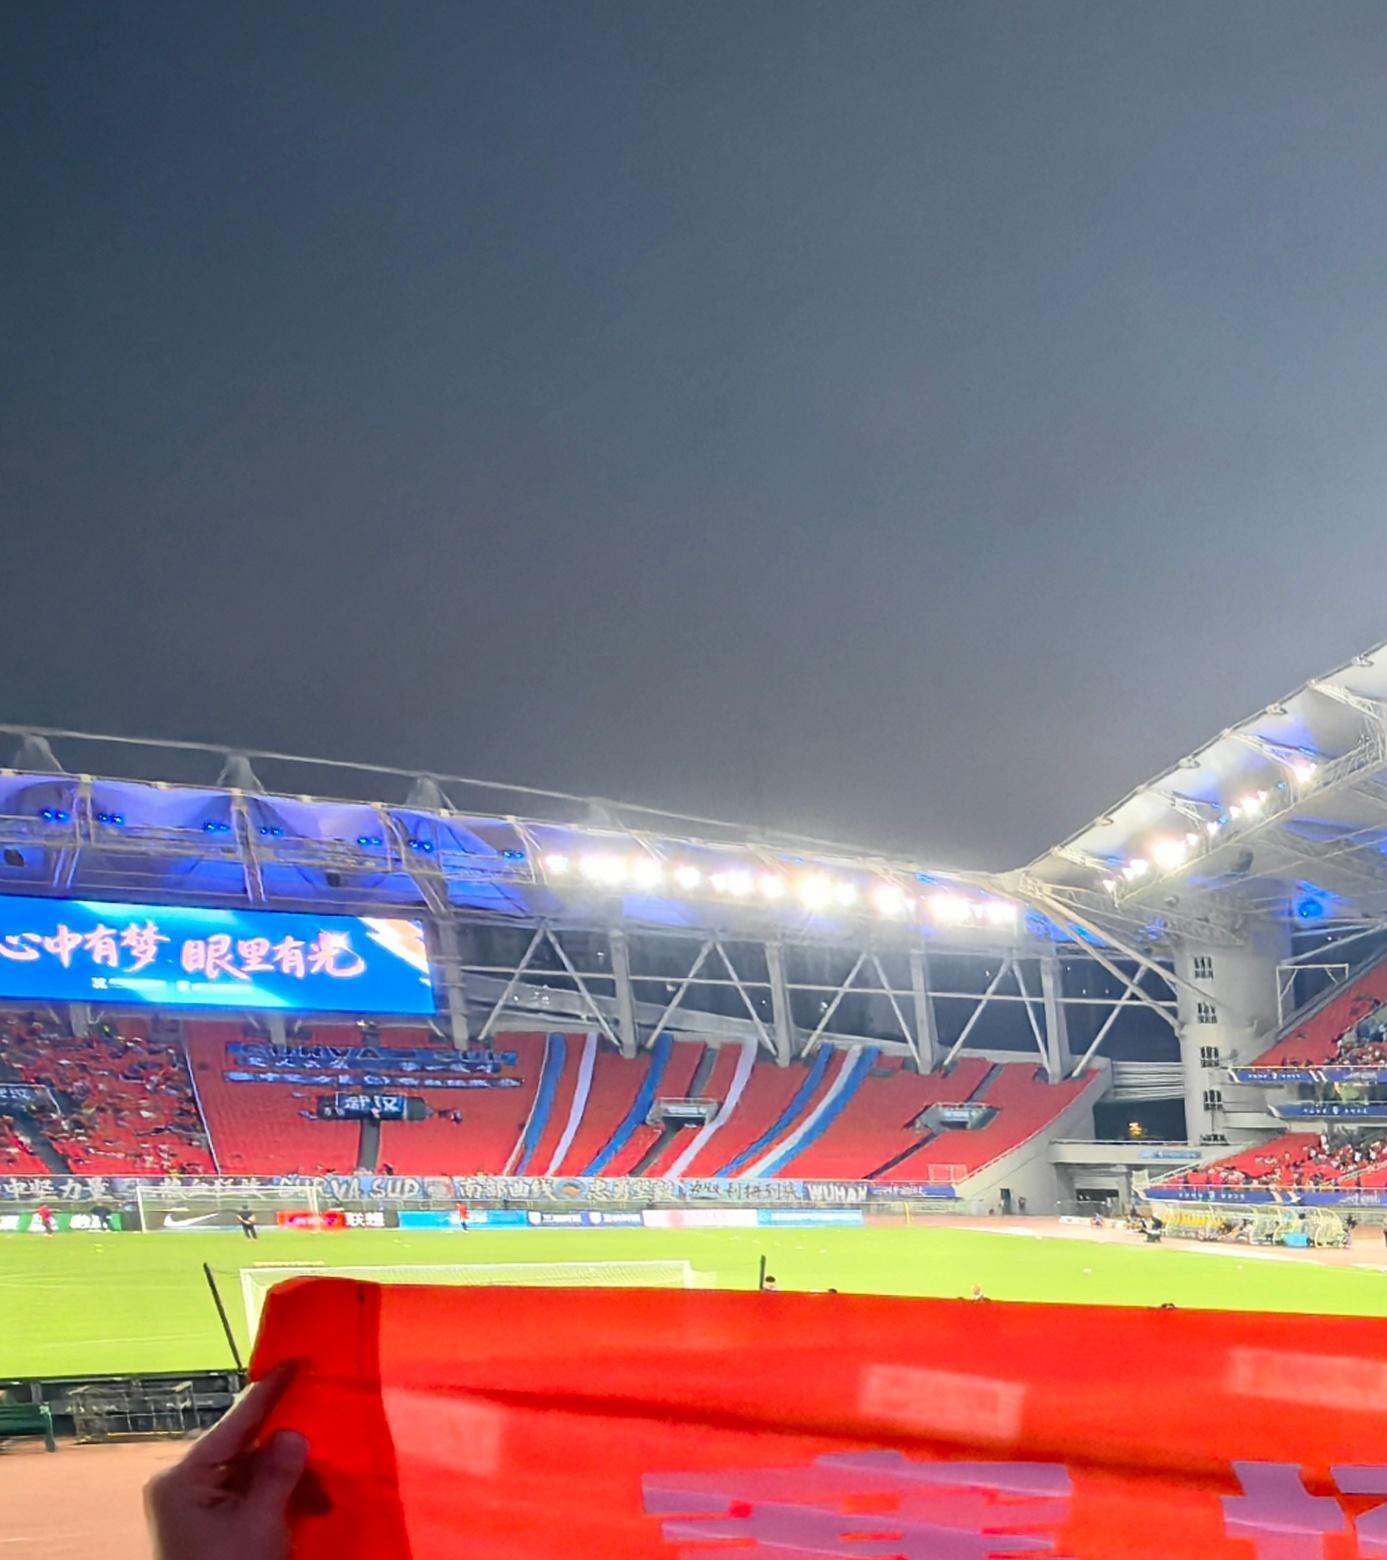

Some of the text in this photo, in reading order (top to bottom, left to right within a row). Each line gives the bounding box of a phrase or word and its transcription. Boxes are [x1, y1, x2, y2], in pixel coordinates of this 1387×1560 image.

[0, 919, 367, 981] 心中有梦 眼里有光
